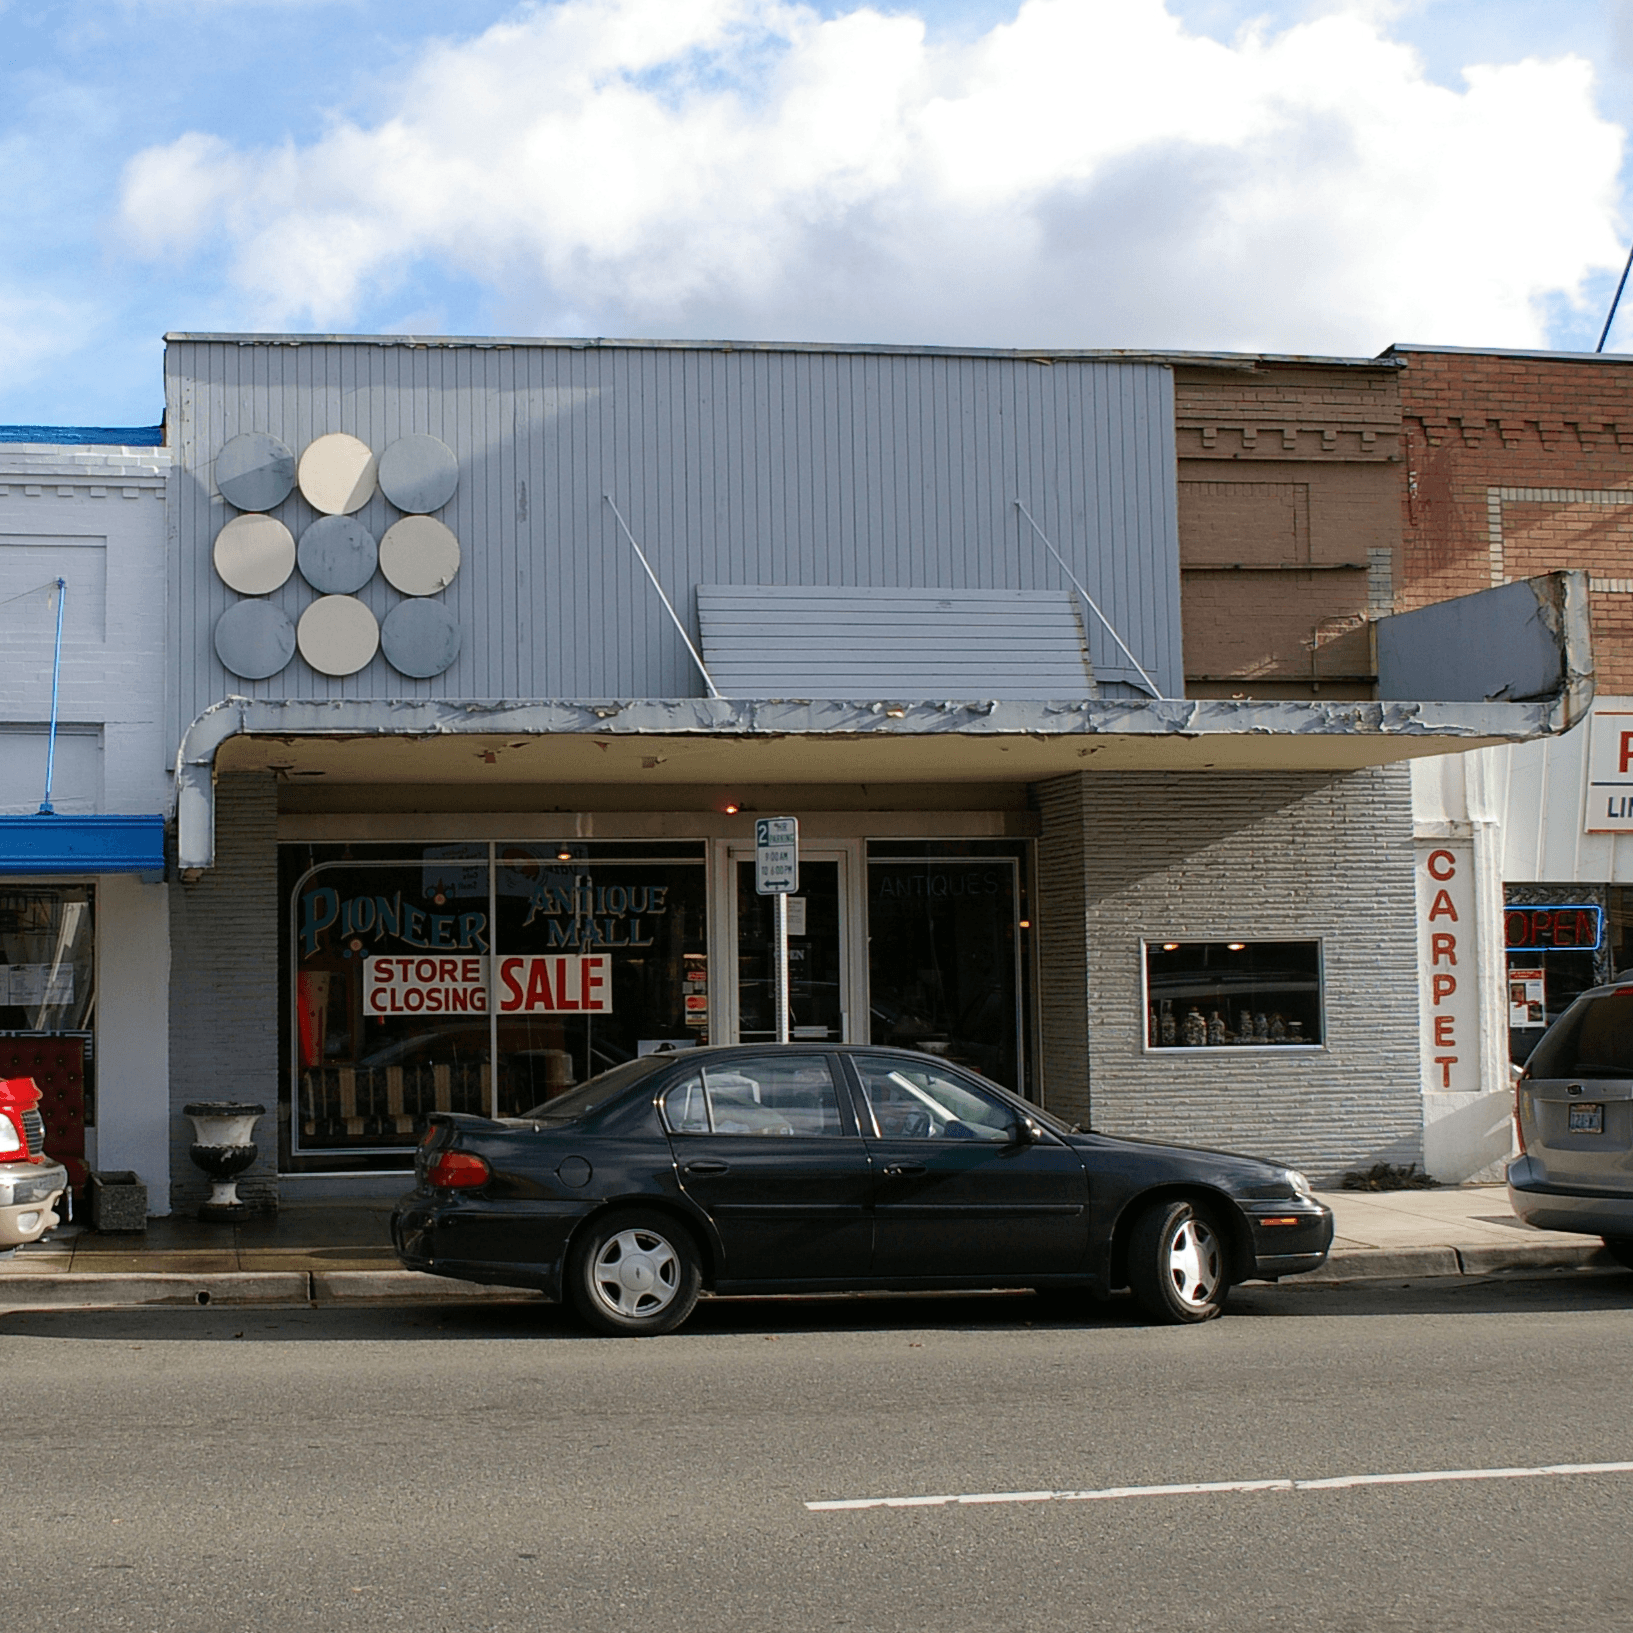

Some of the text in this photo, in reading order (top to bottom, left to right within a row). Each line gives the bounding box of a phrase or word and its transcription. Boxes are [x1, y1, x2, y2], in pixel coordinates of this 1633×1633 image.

[758, 825, 767, 843] 2
[878, 871, 998, 898] ANTIQUES
[300, 886, 491, 959] PIONEER
[523, 885, 669, 927] ANTIQUE
[547, 918, 655, 955] MALL
[1504, 910, 1595, 946] OPEN
[373, 958, 480, 983] STORE
[500, 957, 604, 1012] SALE
[1427, 849, 1458, 1088] CARPET
[370, 986, 488, 1012] CLOSING
